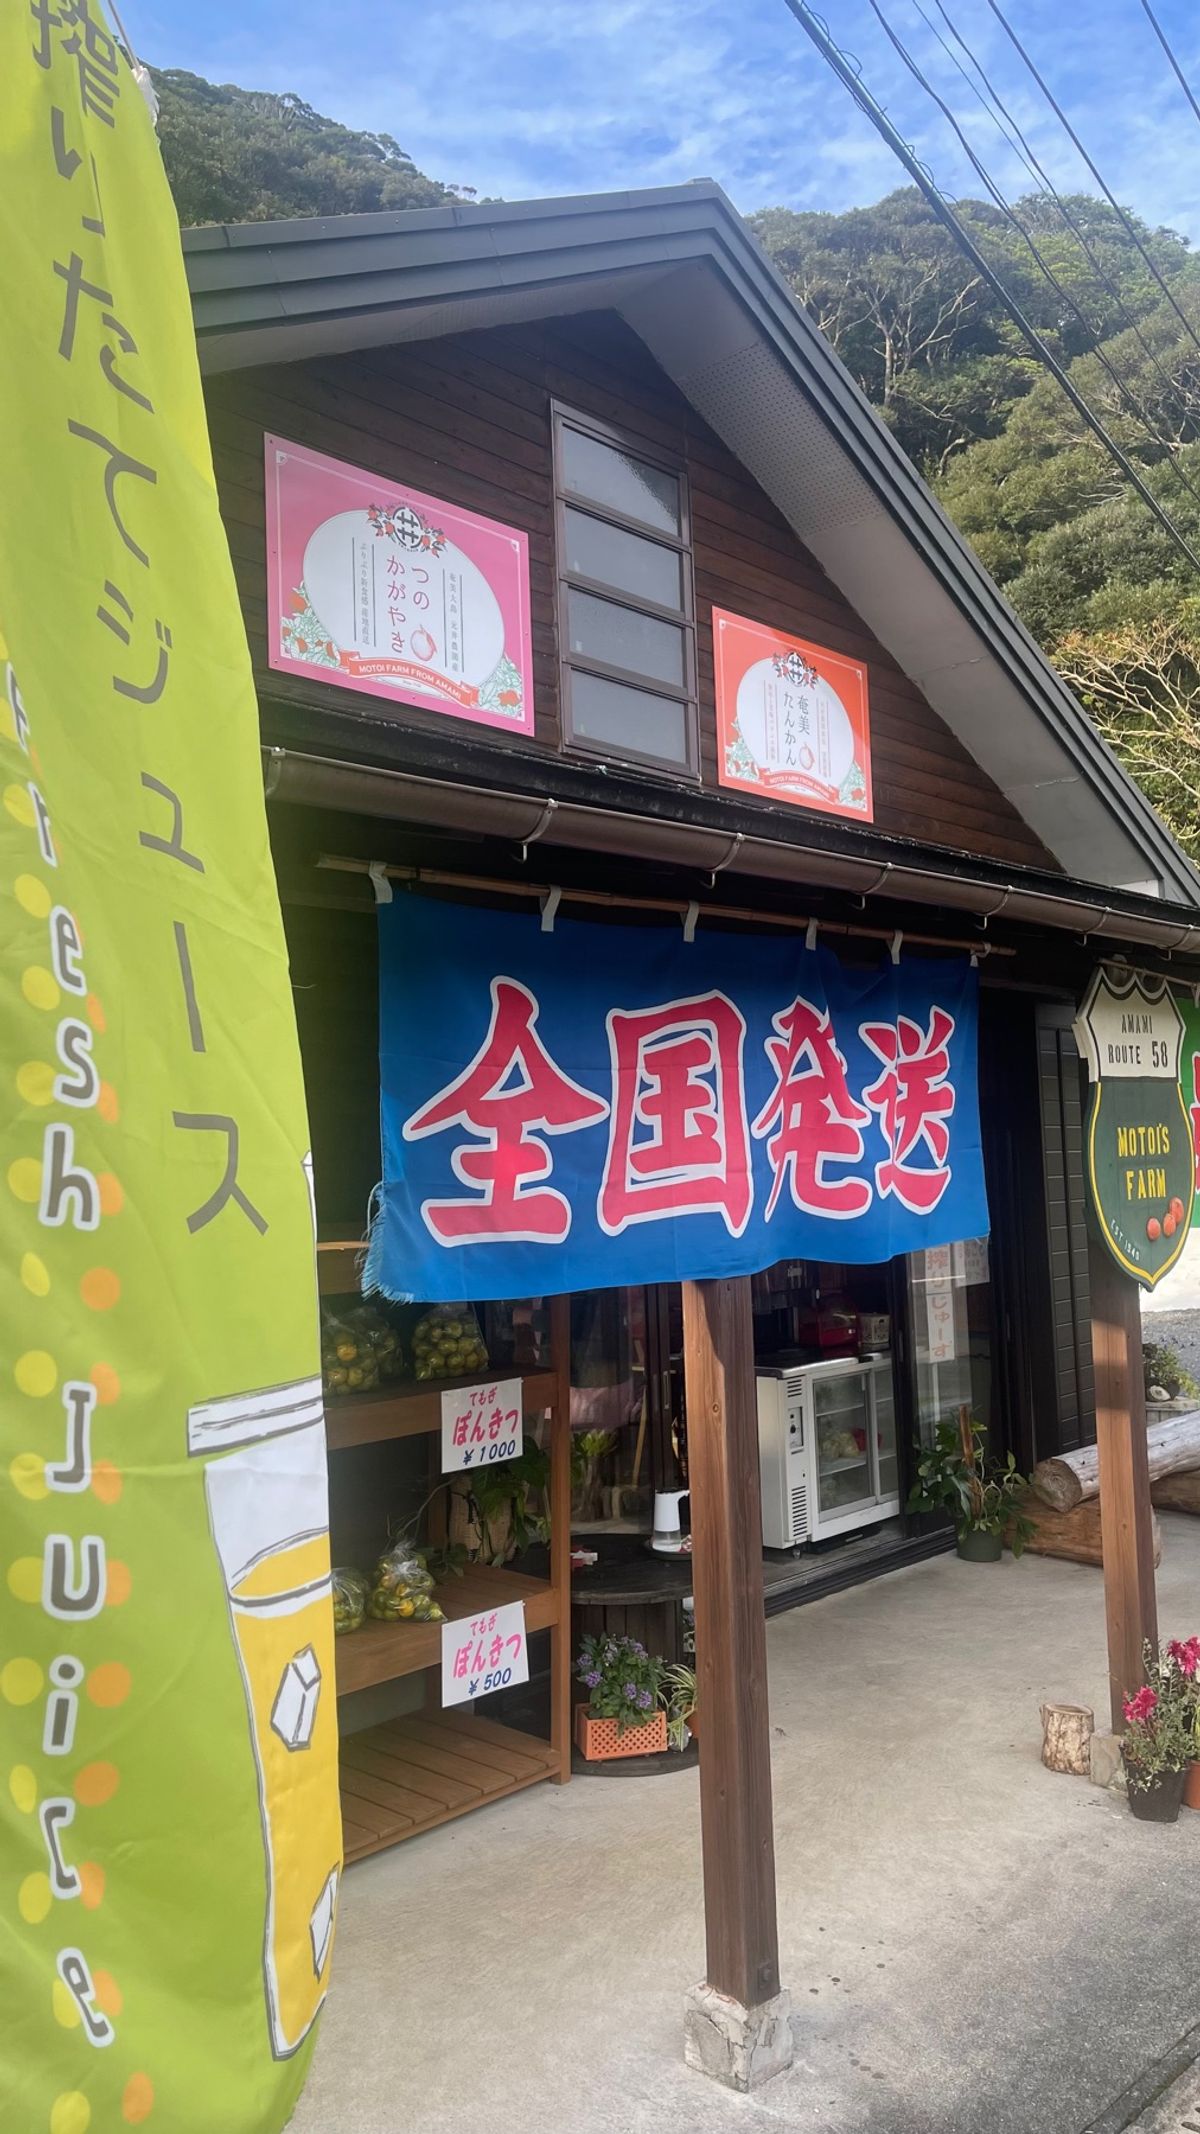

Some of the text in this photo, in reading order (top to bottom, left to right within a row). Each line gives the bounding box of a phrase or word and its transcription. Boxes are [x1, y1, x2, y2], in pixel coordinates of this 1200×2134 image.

[387, 555, 406, 653] かがやき
[412, 568, 430, 610] つの
[359, 664, 461, 699] MOTOI FARM FROM AMAMI
[784, 691, 797, 766] たんかん
[1122, 1014, 1152, 1034] AMAMI
[1108, 1041, 1168, 1068] ROUTE 58
[402, 975, 955, 1247] 全国発送
[1117, 1123, 1170, 1157] MOTOI'S
[1126, 1168, 1166, 1200] FARM
[470, 1386, 498, 1406] てもぎ
[453, 1408, 519, 1446] ぽんきつ
[471, 1613, 498, 1636] てもぎ
[453, 1634, 522, 1678] ぽんきつ
[40, 1379, 115, 2047] Juice
